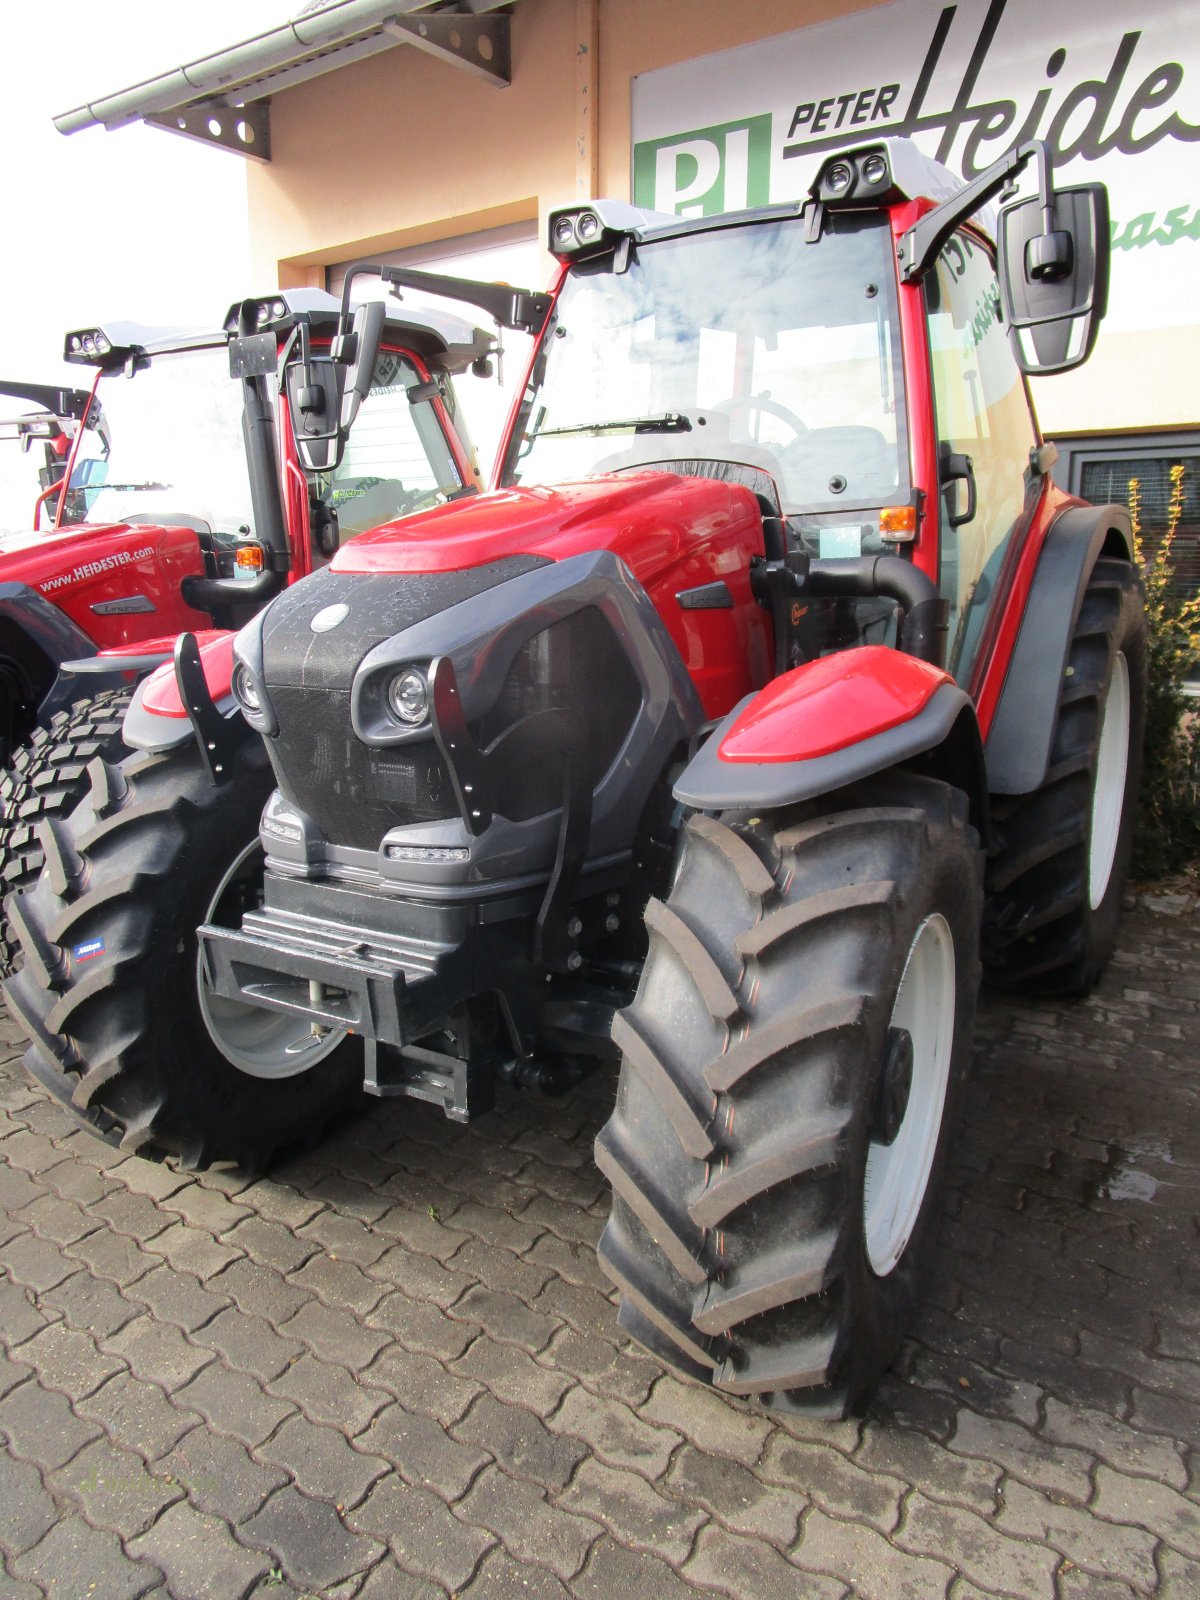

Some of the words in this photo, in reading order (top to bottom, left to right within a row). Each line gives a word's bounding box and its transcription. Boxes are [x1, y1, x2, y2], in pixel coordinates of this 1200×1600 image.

[787, 83, 901, 139] PETER
[900, 0, 1200, 182] Heide
[40, 546, 155, 593] www.HEIDESTER.com
